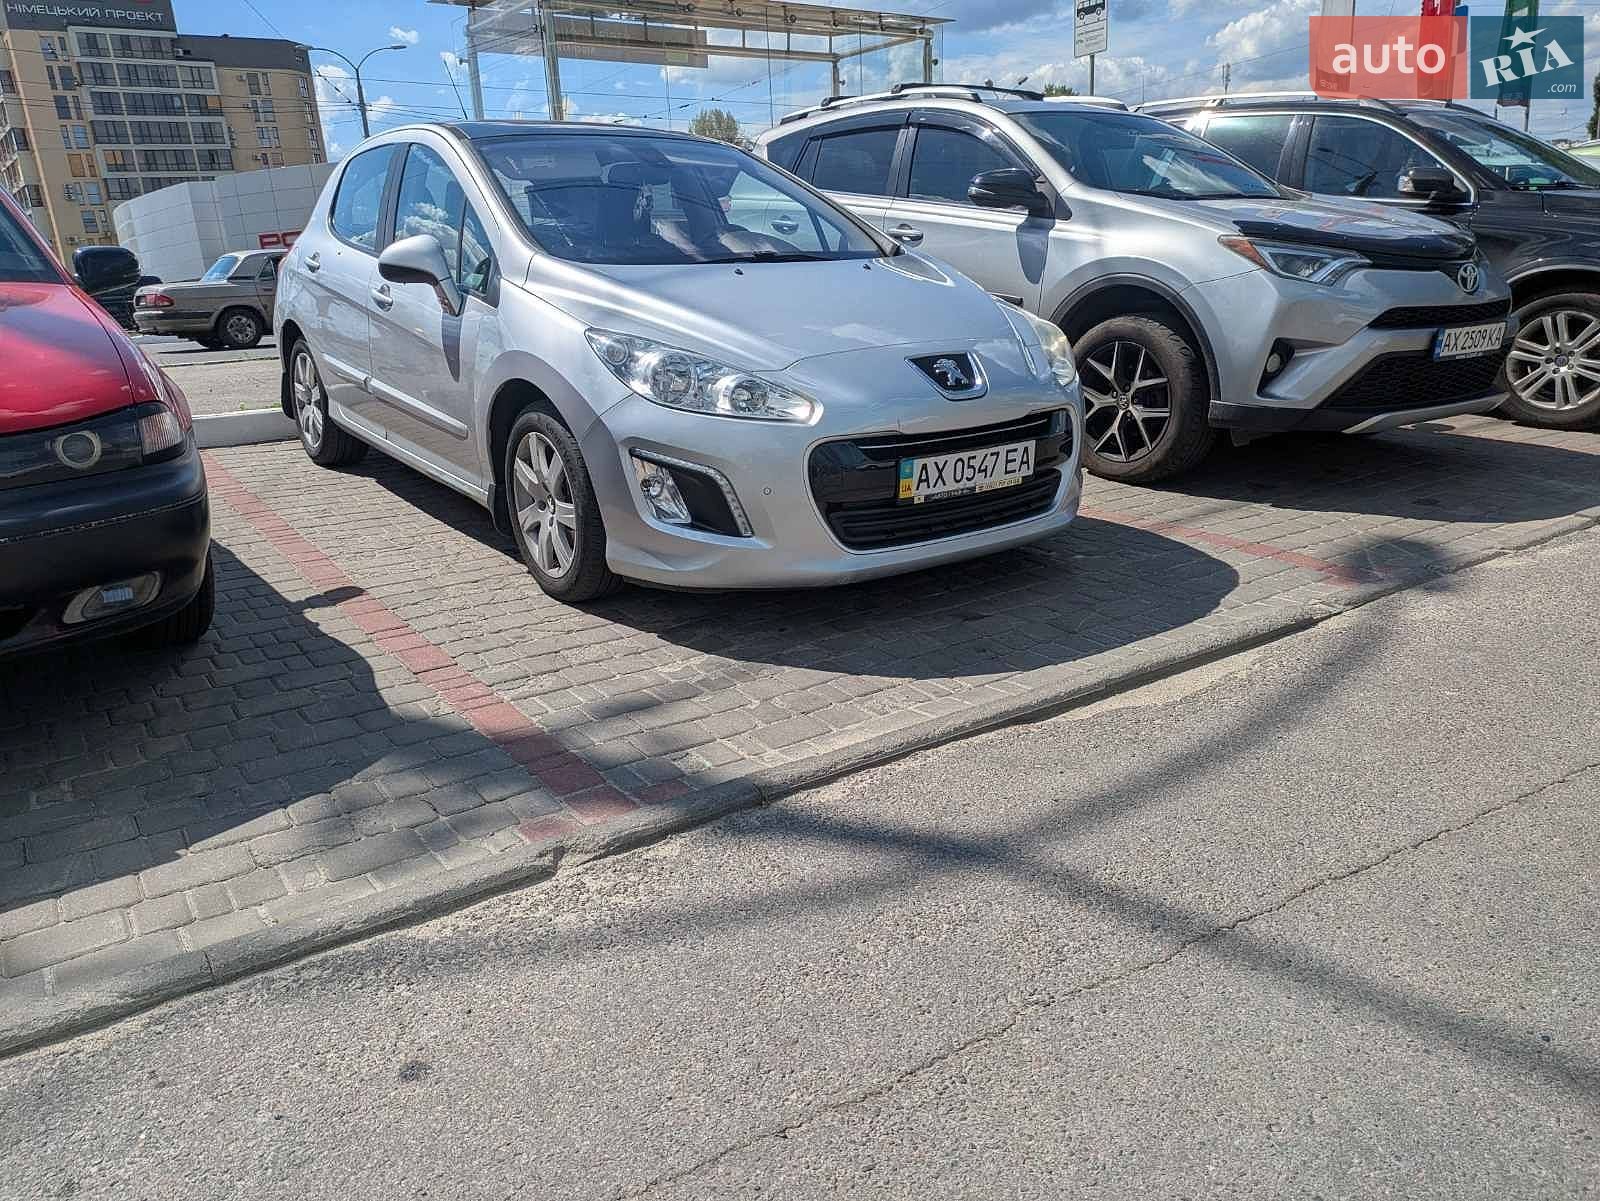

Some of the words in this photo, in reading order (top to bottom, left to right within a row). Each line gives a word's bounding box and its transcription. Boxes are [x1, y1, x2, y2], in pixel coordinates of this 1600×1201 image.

[7, 3, 101, 17] НІМЕЦЬКИЙ
[105, 8, 164, 23] ПРОЕКТ
[1441, 332, 1462, 352] AX
[1461, 329, 1487, 350] 2509
[1487, 326, 1502, 346] KA
[916, 462, 948, 490] AX
[953, 452, 1000, 483] 0547
[1004, 446, 1030, 475] EA
